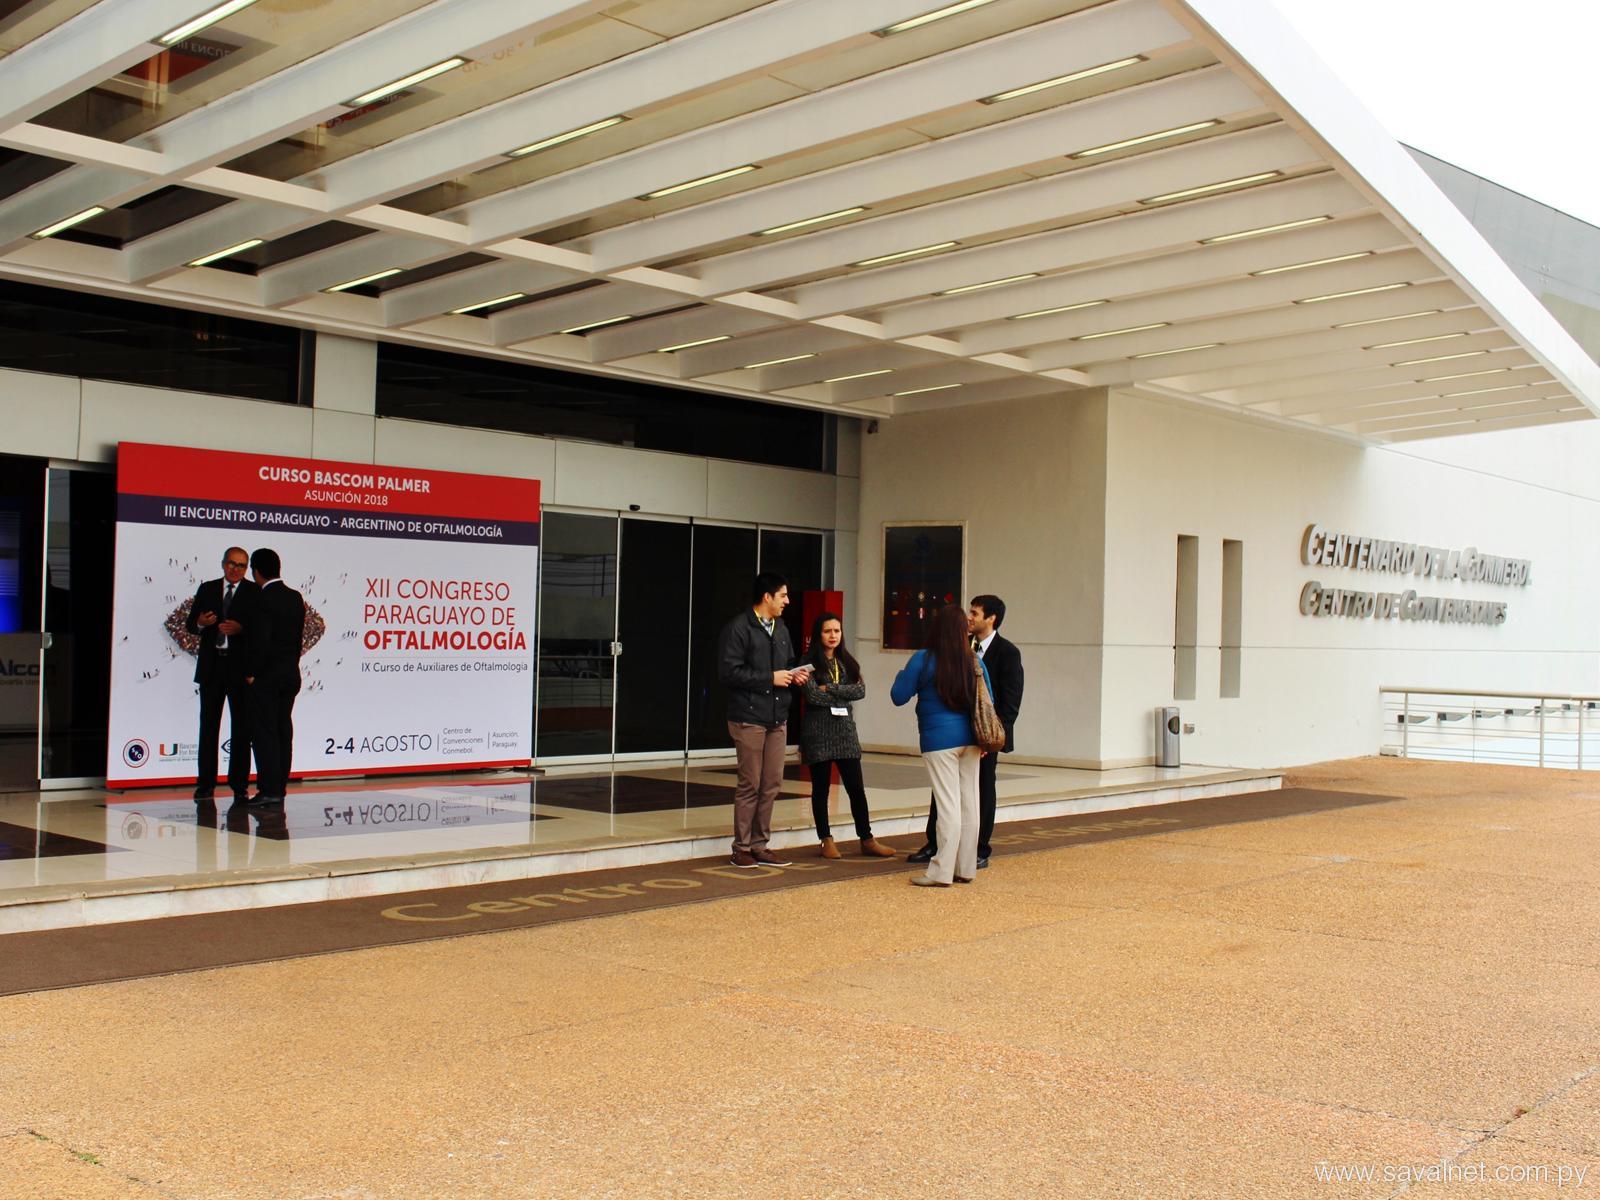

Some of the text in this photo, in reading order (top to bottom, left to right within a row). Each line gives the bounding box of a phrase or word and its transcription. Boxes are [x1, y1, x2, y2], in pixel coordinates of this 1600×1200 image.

[258, 466, 431, 493] CURSO BASCOM PALMER
[304, 489, 389, 506] ASUNCIÓN 2018
[164, 505, 176, 517] III
[179, 506, 257, 522] ENCUENTRO
[260, 511, 331, 527] PARAGUAYO
[340, 517, 404, 532] ARGENTINO
[407, 521, 422, 533] DE
[423, 522, 504, 538] OFTALMOLOGÍA
[365, 578, 510, 601] XII CONGRESO
[364, 604, 516, 626] PARAGUAYO DE
[363, 627, 527, 650] OFTALMOLOGÍA
[361, 662, 371, 672] IX
[373, 662, 400, 672] Curso
[403, 661, 414, 672] de
[416, 661, 459, 672] Auxiliares
[460, 660, 472, 672] de
[442, 727, 472, 736] Centro de
[442, 736, 484, 746] Convenciones
[324, 734, 432, 755] 2-4 AGOSTO
[380, 877, 704, 923] Centro
